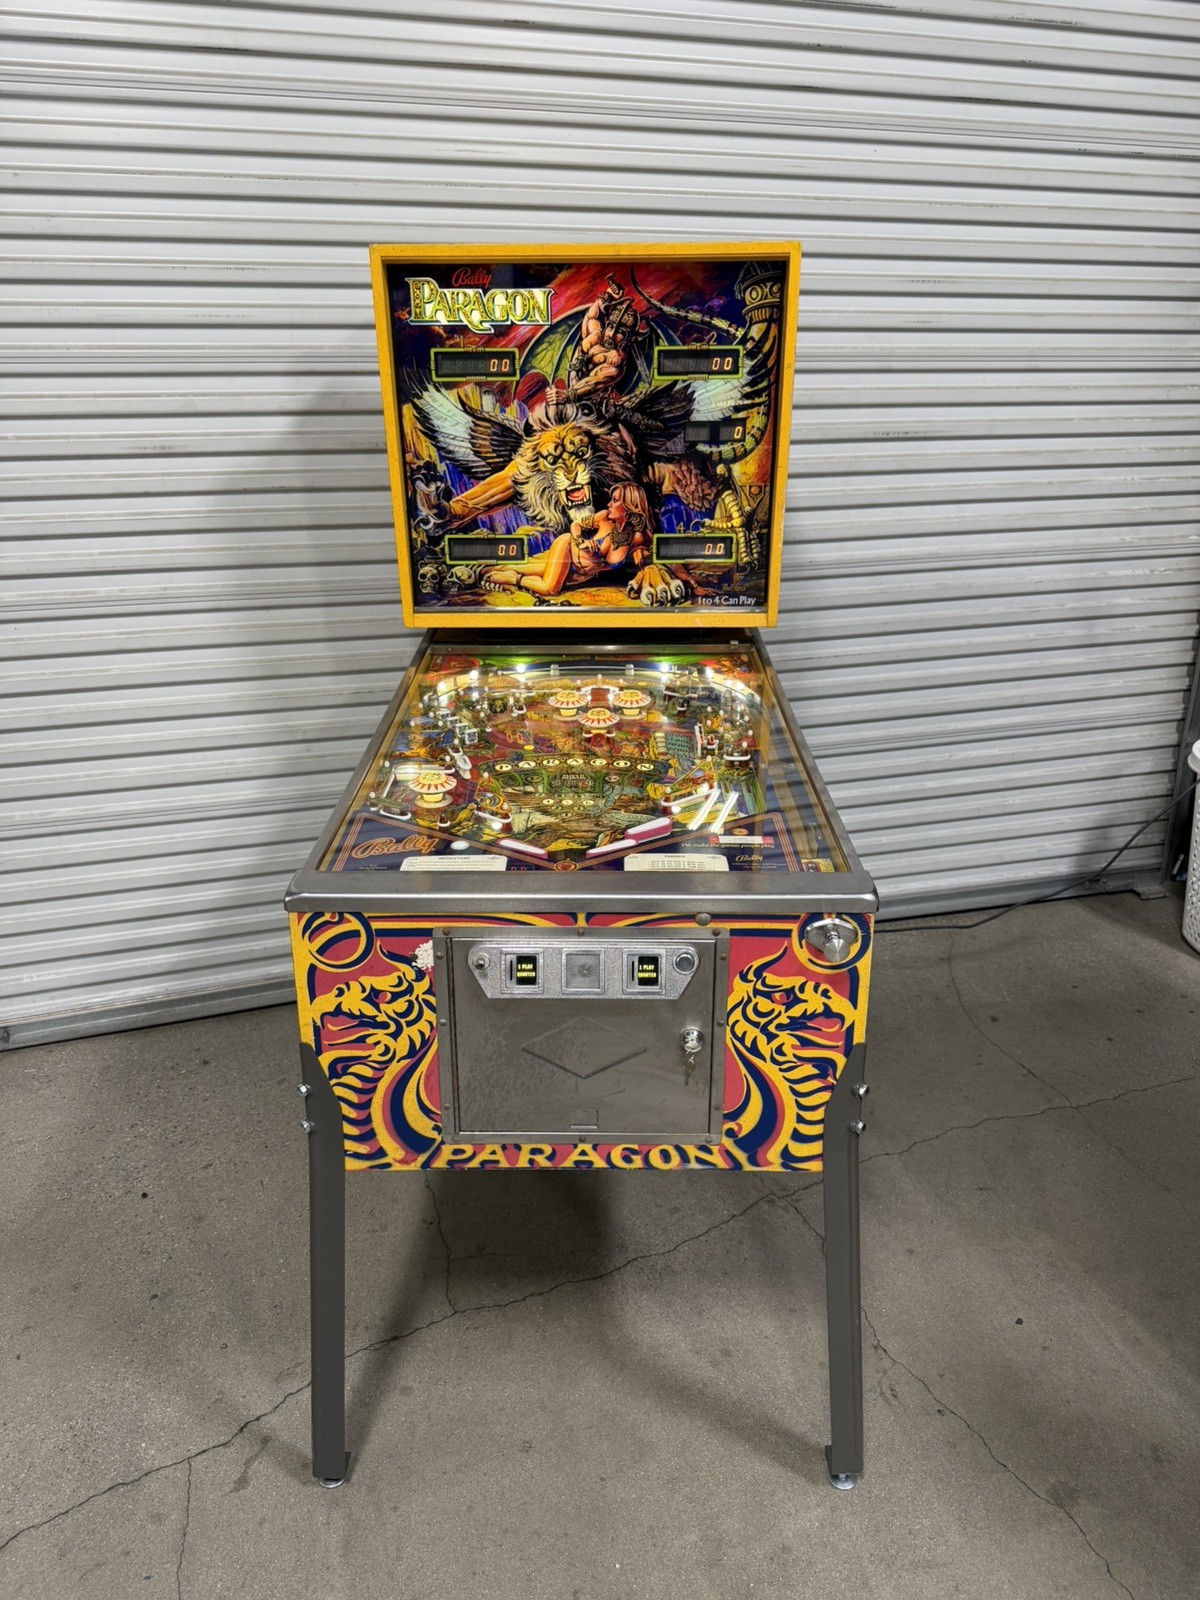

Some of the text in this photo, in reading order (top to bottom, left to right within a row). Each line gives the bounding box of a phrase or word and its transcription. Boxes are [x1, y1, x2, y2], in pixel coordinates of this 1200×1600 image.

[452, 267, 491, 289] Bally
[405, 278, 555, 333] PARAGON
[702, 597, 712, 605] to
[713, 596, 720, 605] 4
[721, 595, 739, 605] Can
[739, 595, 756, 606] Play
[351, 835, 439, 858] Bally
[432, 1143, 731, 1170] PARAGON
